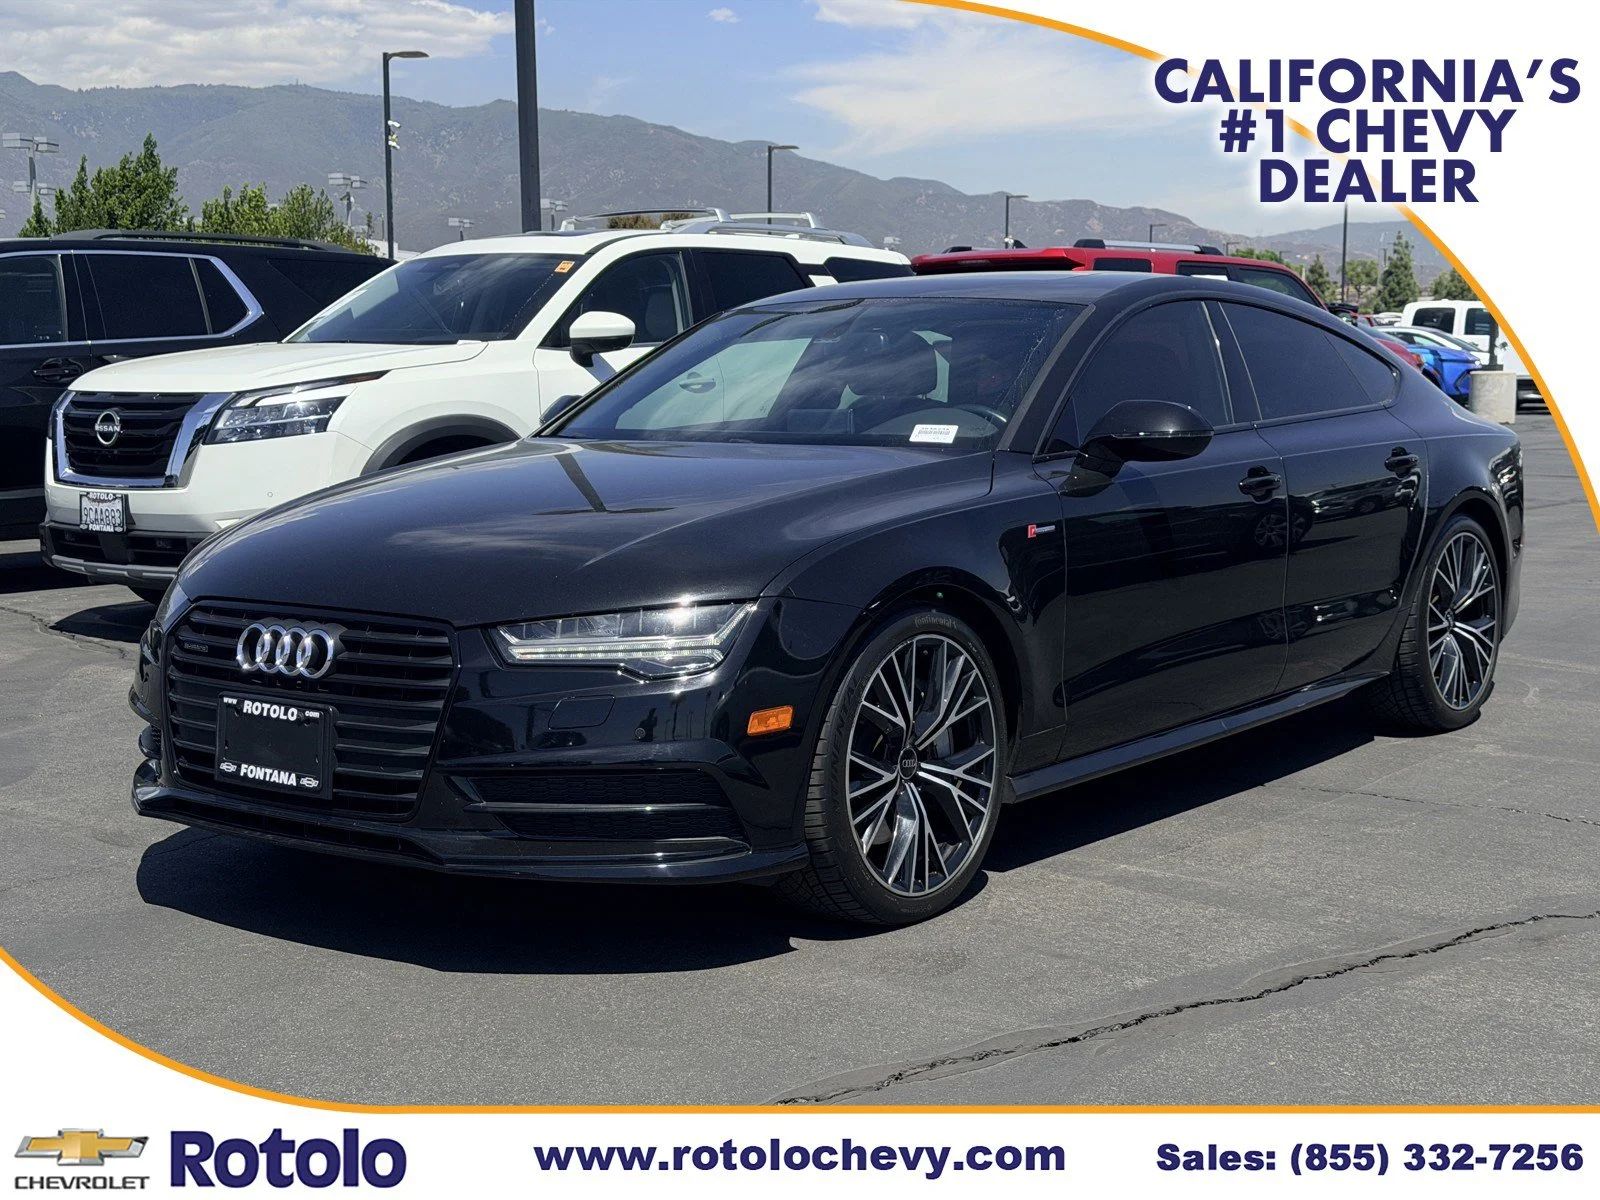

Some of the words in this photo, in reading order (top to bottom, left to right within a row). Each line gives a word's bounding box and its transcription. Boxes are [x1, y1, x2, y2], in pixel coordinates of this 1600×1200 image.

[242, 700, 298, 721] ROTOLO
[304, 710, 320, 718] com
[240, 763, 297, 786] FONTANA
